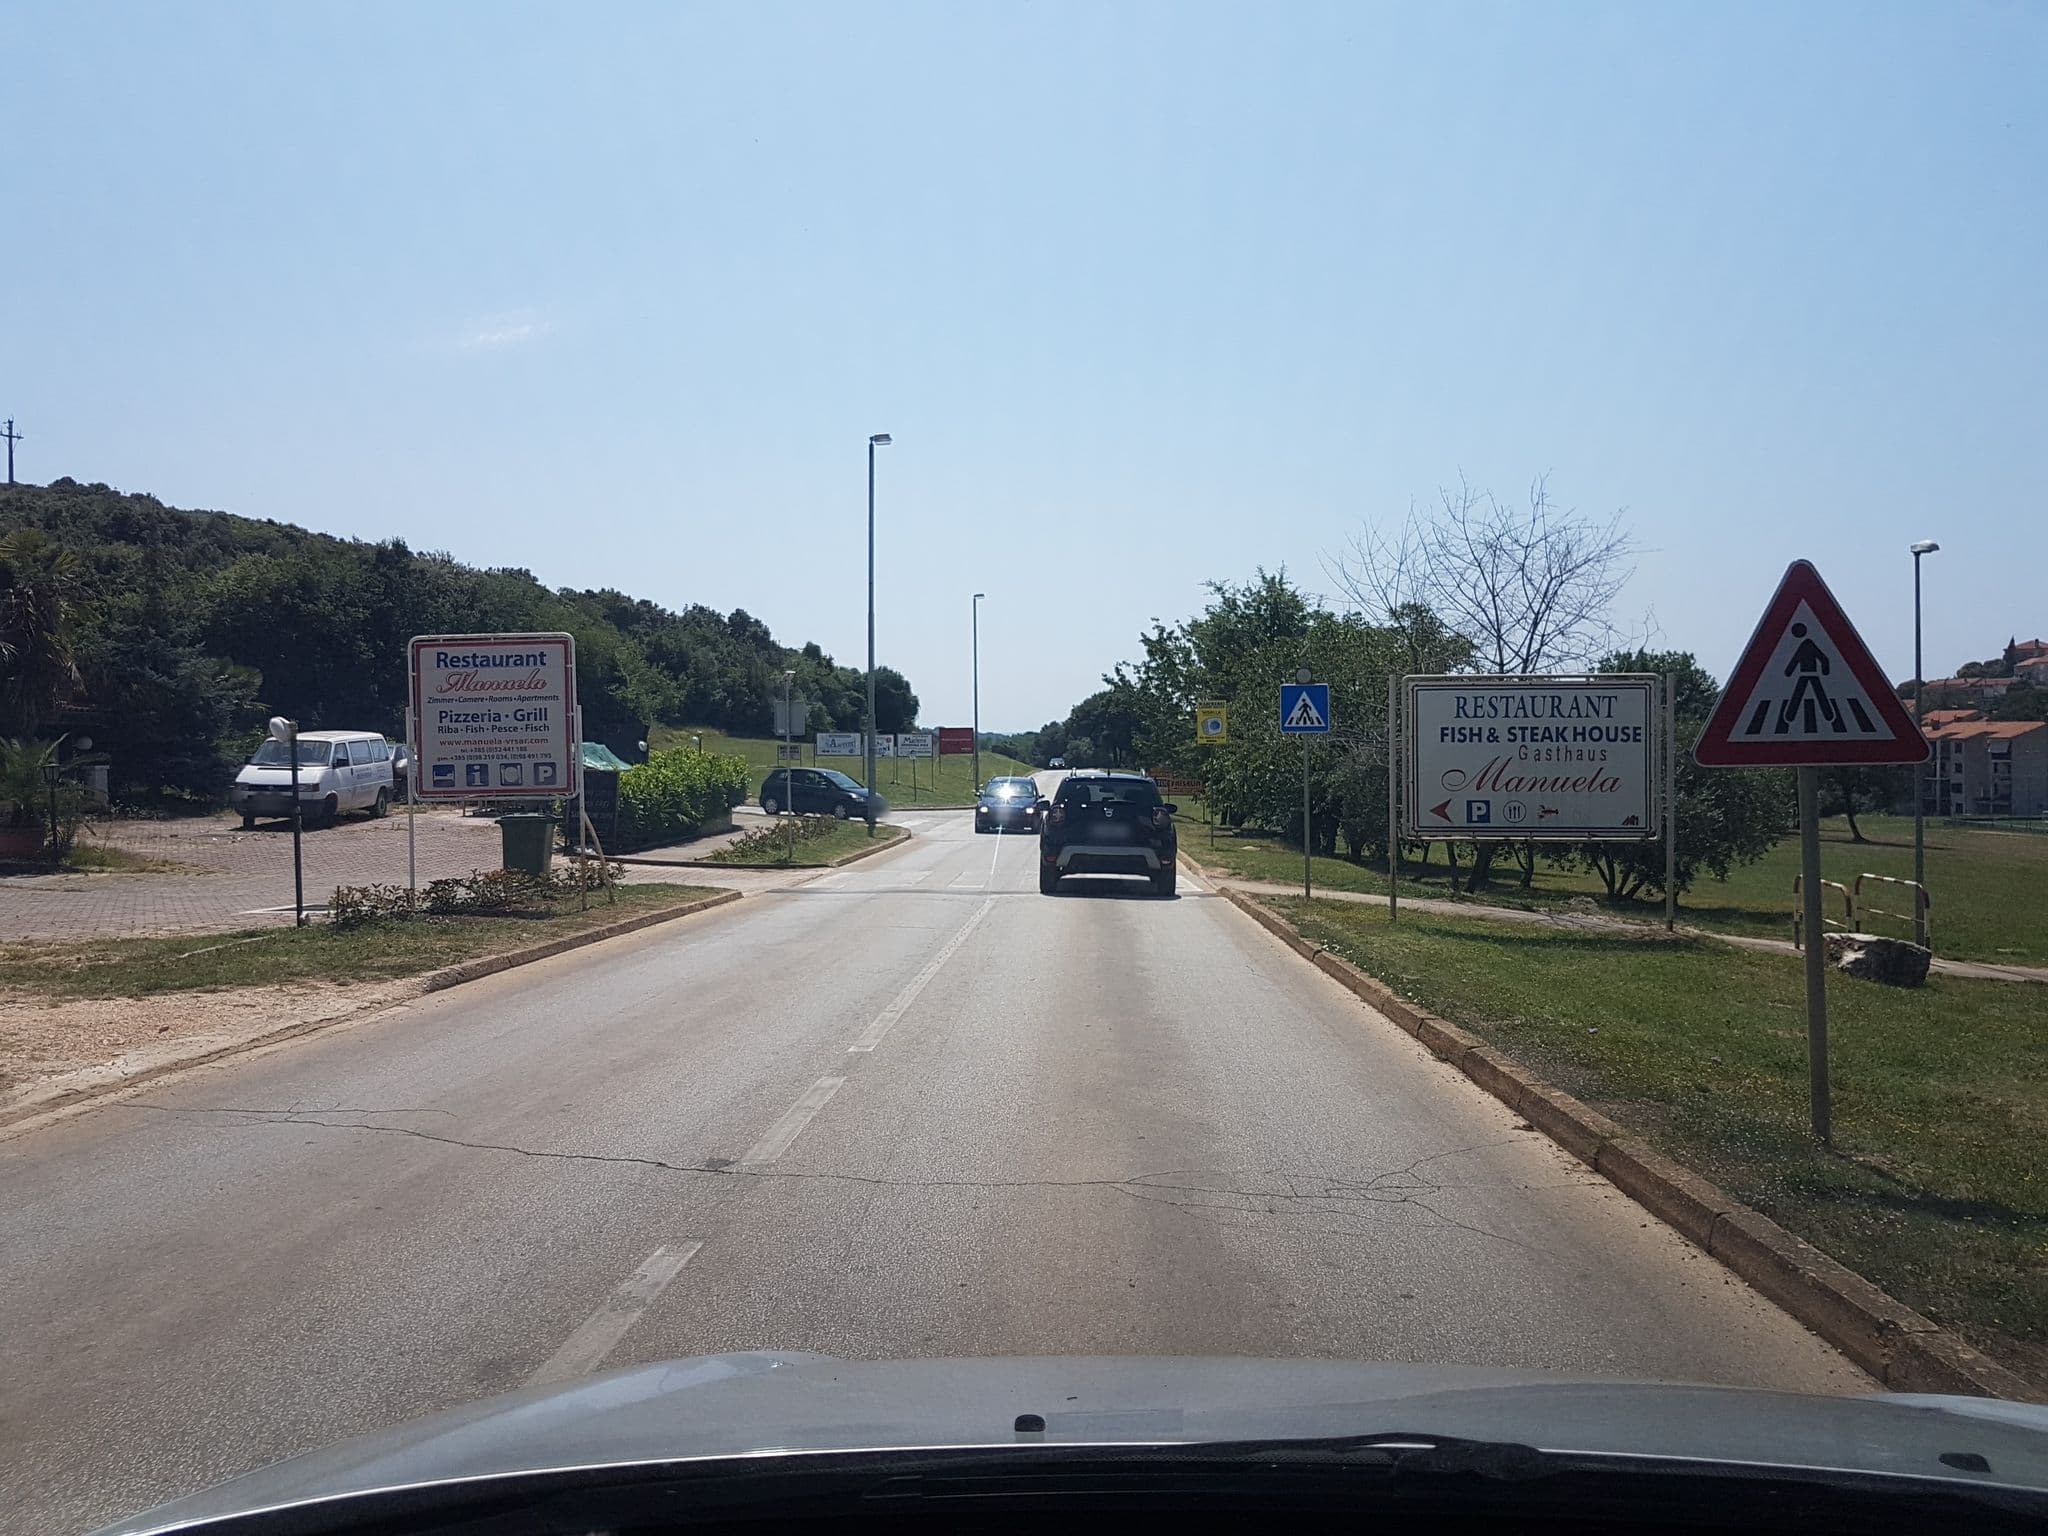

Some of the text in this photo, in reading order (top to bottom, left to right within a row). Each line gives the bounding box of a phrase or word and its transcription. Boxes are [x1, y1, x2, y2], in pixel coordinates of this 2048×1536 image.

[436, 651, 547, 668] Restaurant
[436, 669, 548, 693] Manuela
[439, 707, 548, 723] Pizzeria Grill
[1453, 695, 1618, 719] RESTAURANT
[438, 722, 550, 734] Riba Fish Pesce Fisch
[1440, 726, 1642, 743] FISH & STEAK HOUSE
[1518, 745, 1608, 762] Gasthaus
[1441, 755, 1623, 793] Manuela
